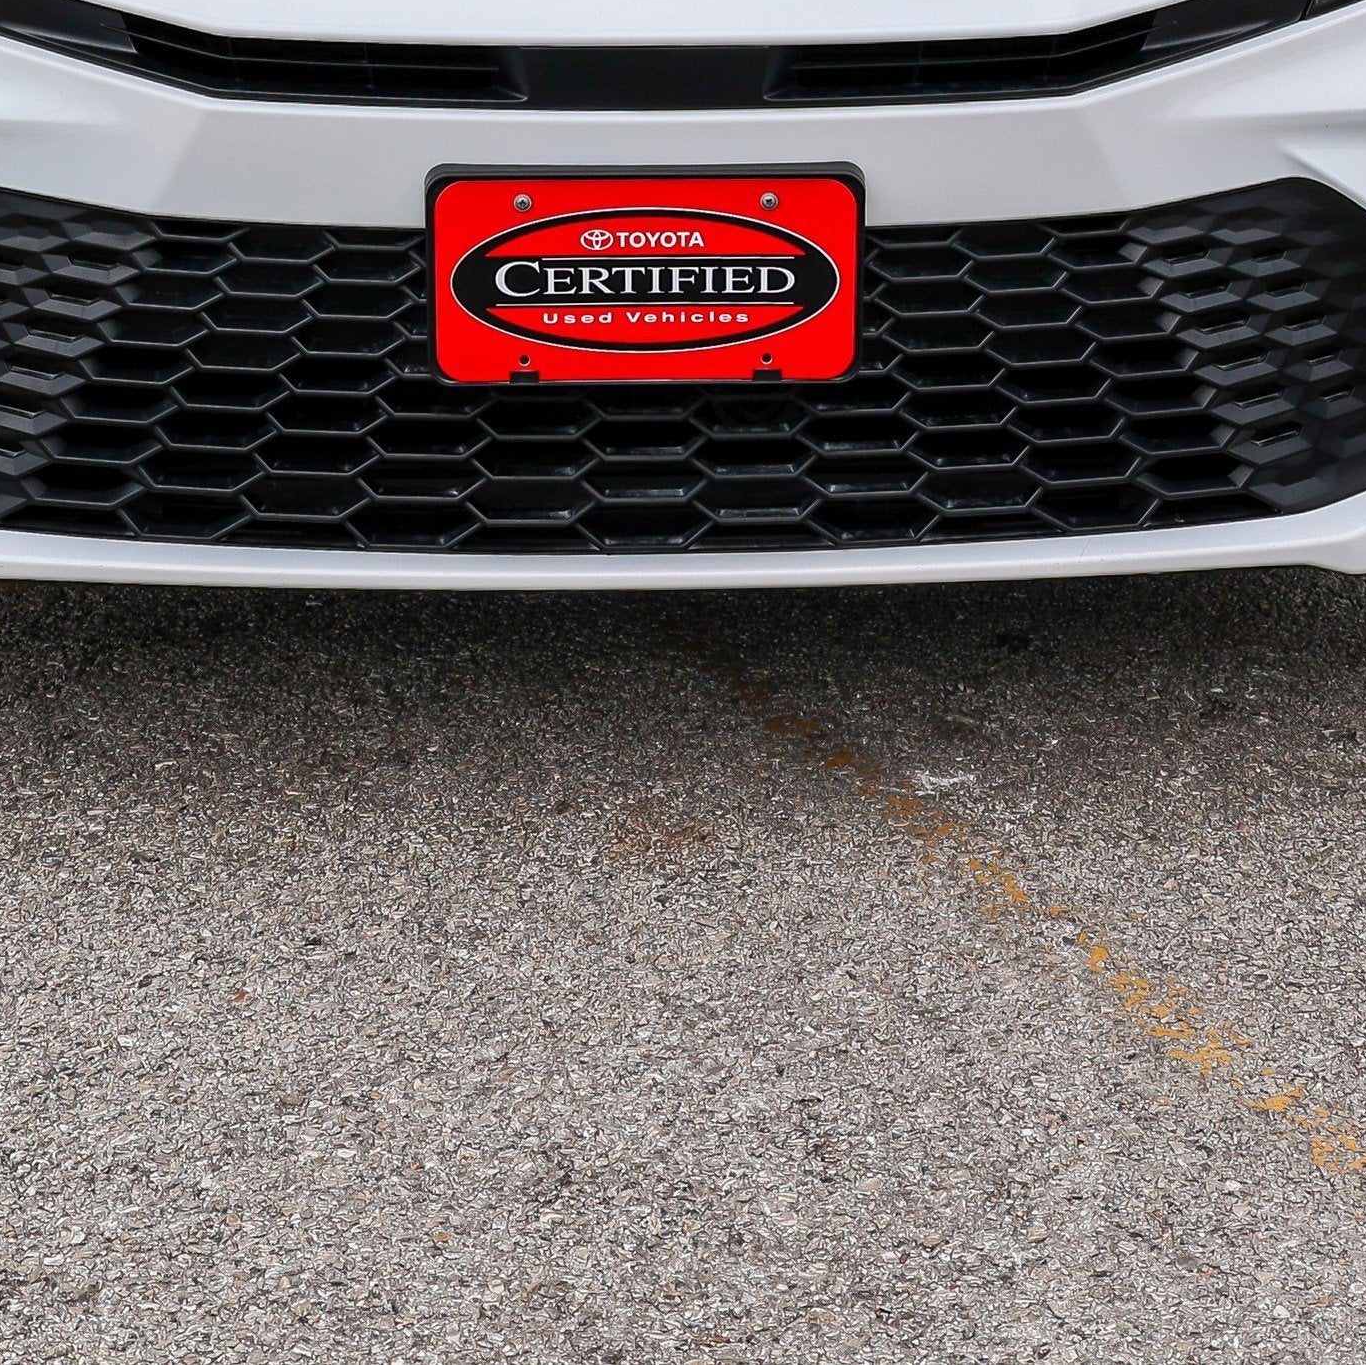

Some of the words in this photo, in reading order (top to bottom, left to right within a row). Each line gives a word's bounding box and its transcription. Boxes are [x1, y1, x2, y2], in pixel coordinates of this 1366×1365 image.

[617, 231, 705, 248] TOYOTA
[494, 260, 796, 297] CERTIFIED
[542, 311, 613, 325] Used
[626, 310, 750, 325] Vehicles
